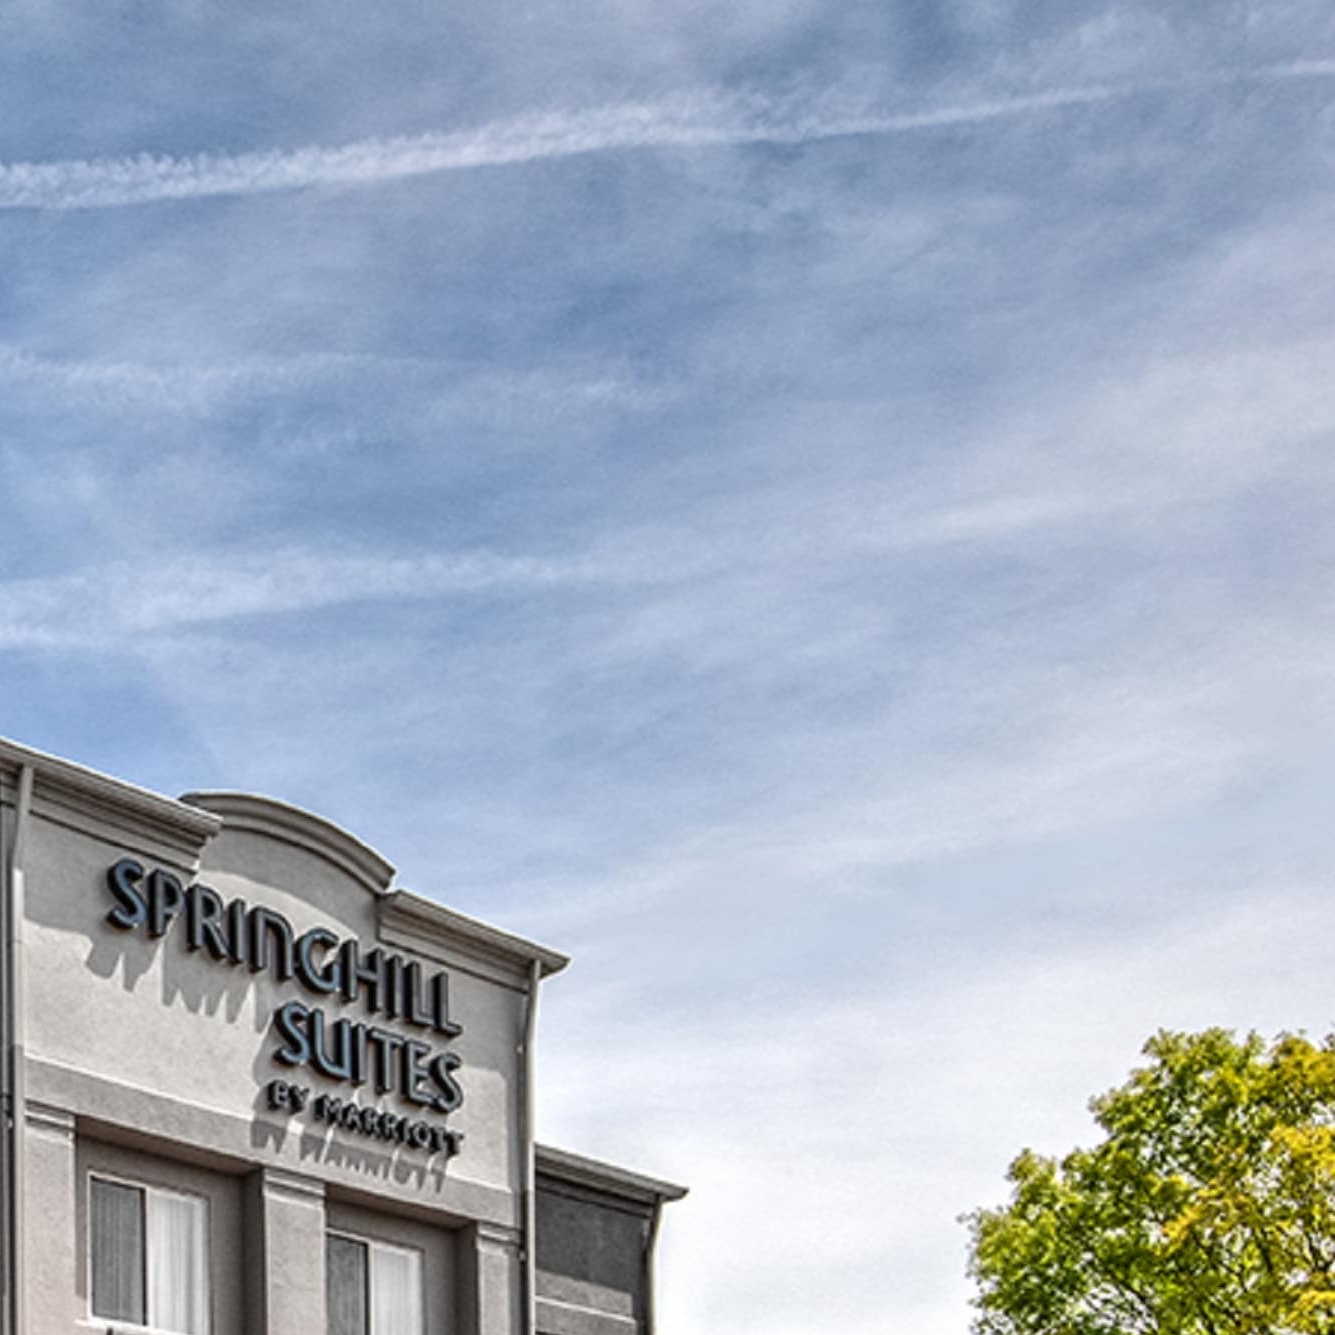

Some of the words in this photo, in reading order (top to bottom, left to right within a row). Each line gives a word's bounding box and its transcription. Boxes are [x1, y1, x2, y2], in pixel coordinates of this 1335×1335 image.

[106, 857, 462, 1037] SPRINGHILL
[274, 1000, 464, 1113] SUITES
[266, 1079, 310, 1116] BY
[313, 1094, 465, 1159] MARRIOTT
